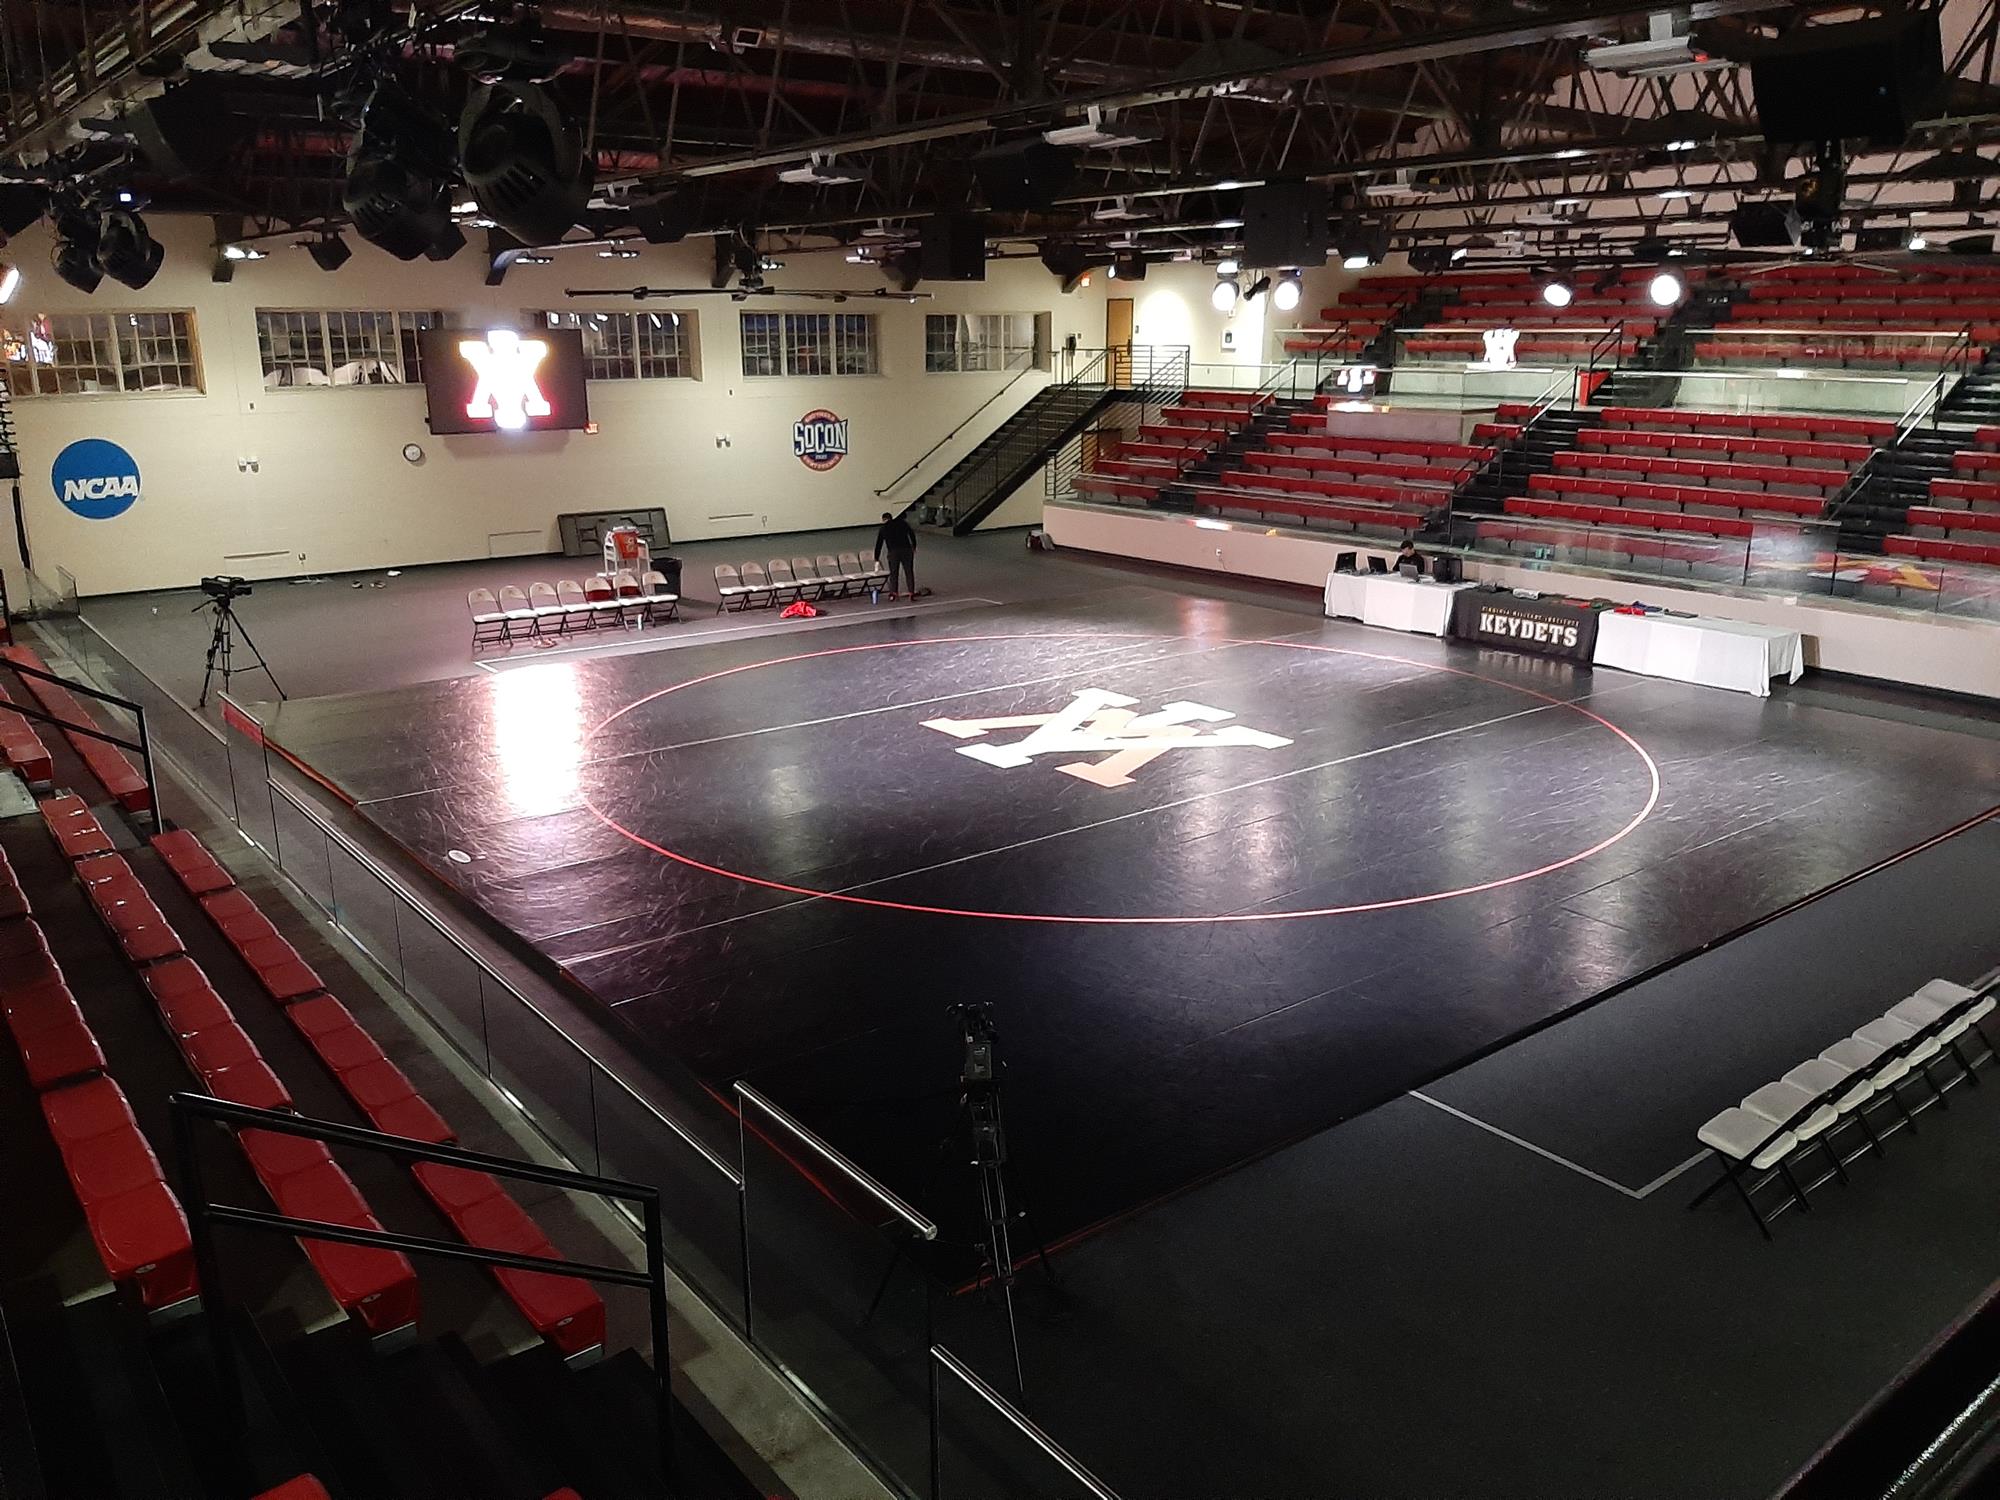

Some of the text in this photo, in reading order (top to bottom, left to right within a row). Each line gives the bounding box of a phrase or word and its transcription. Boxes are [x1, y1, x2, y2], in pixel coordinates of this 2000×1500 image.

[794, 420, 847, 456] SOCON
[64, 475, 138, 502] NCAA
[1479, 612, 1579, 648] KEYDETS
